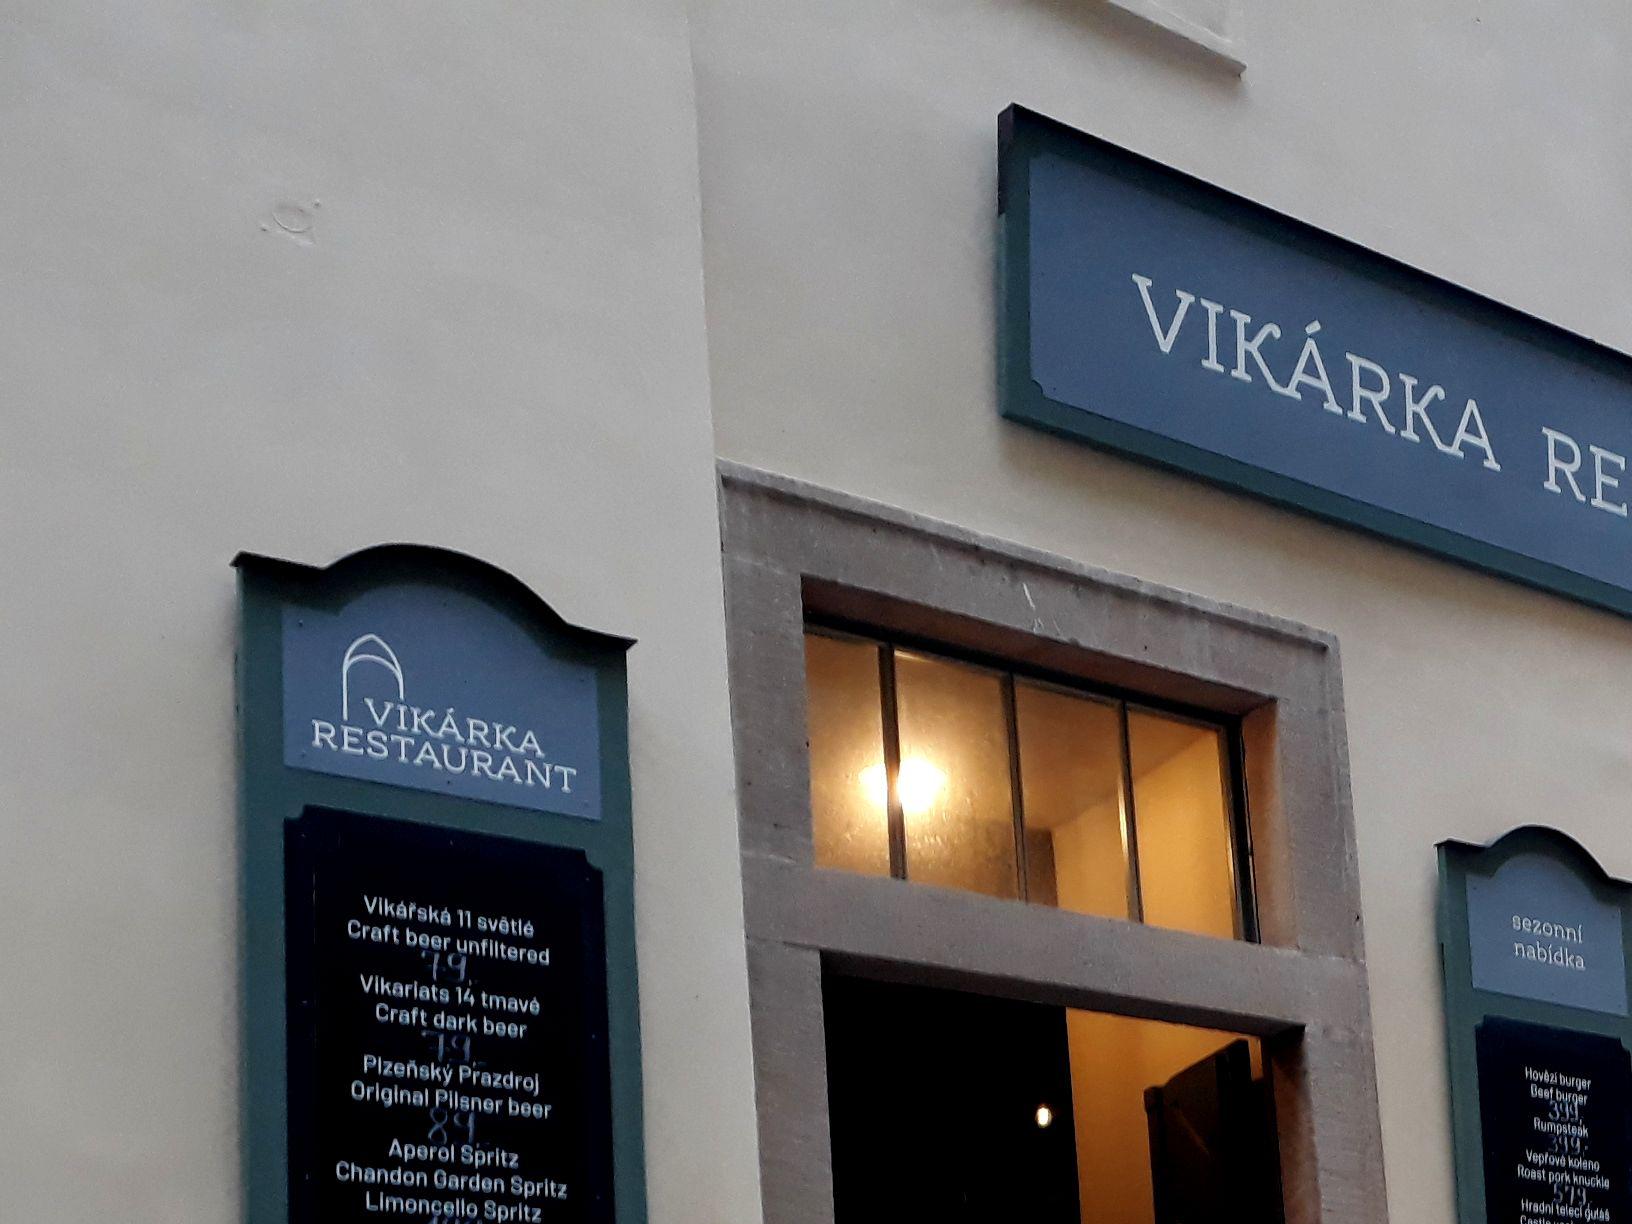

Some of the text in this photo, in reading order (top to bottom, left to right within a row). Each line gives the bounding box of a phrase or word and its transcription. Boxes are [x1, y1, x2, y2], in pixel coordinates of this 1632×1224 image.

[1132, 273, 1502, 472] VIKÁRKA
[363, 697, 545, 758] VIKÁRKA
[312, 719, 577, 794] RESTAURANT
[457, 909, 472, 930] 11
[478, 915, 534, 938] světlé
[1512, 914, 1583, 944] sezonní
[347, 919, 550, 966] Craft beer unfiltered
[1514, 940, 1586, 971] nabídka
[360, 973, 541, 1016] Vikariats 14 tmavé
[375, 1003, 527, 1039] Craft dark beer
[363, 1054, 540, 1096] Plzeňský Prazdroj
[1525, 1066, 1592, 1091] Hovězí burger
[351, 1080, 551, 1119] Original Pilsner beer
[1531, 1084, 1588, 1106] Beef burger
[1534, 1116, 1589, 1138] Rumpsteak
[389, 1138, 519, 1169] Aperol Spritz
[1568, 1156, 1600, 1172] koleno
[336, 1161, 568, 1199] Chandon Garden Spritz
[1517, 1164, 1610, 1190] Roast pork knuckle
[366, 1191, 542, 1223] Limoncello Spritz
[1521, 1198, 1554, 1215] Hradní
